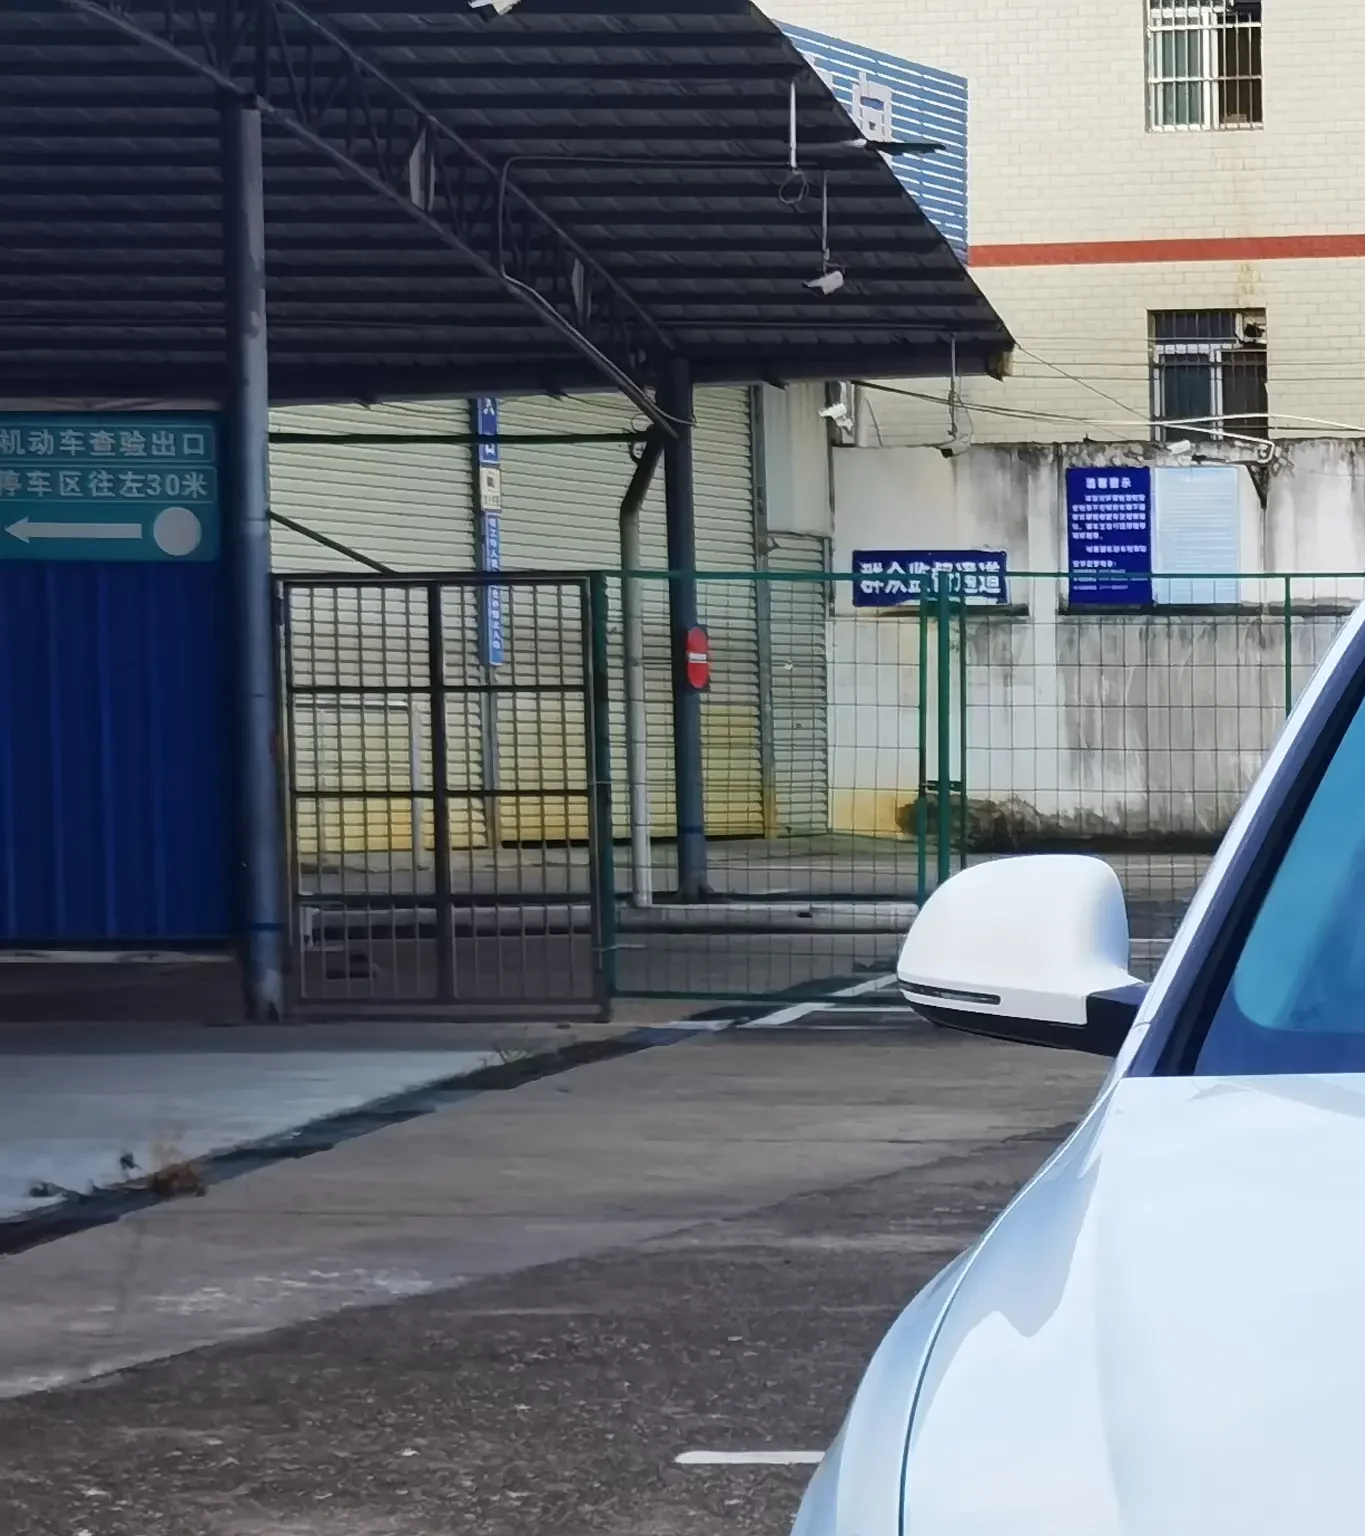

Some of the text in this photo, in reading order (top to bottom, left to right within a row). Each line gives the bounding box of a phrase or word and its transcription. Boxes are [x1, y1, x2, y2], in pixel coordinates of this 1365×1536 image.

[0, 429, 205, 456] 机动车查验出口
[0, 470, 208, 498] 停车区往左30米
